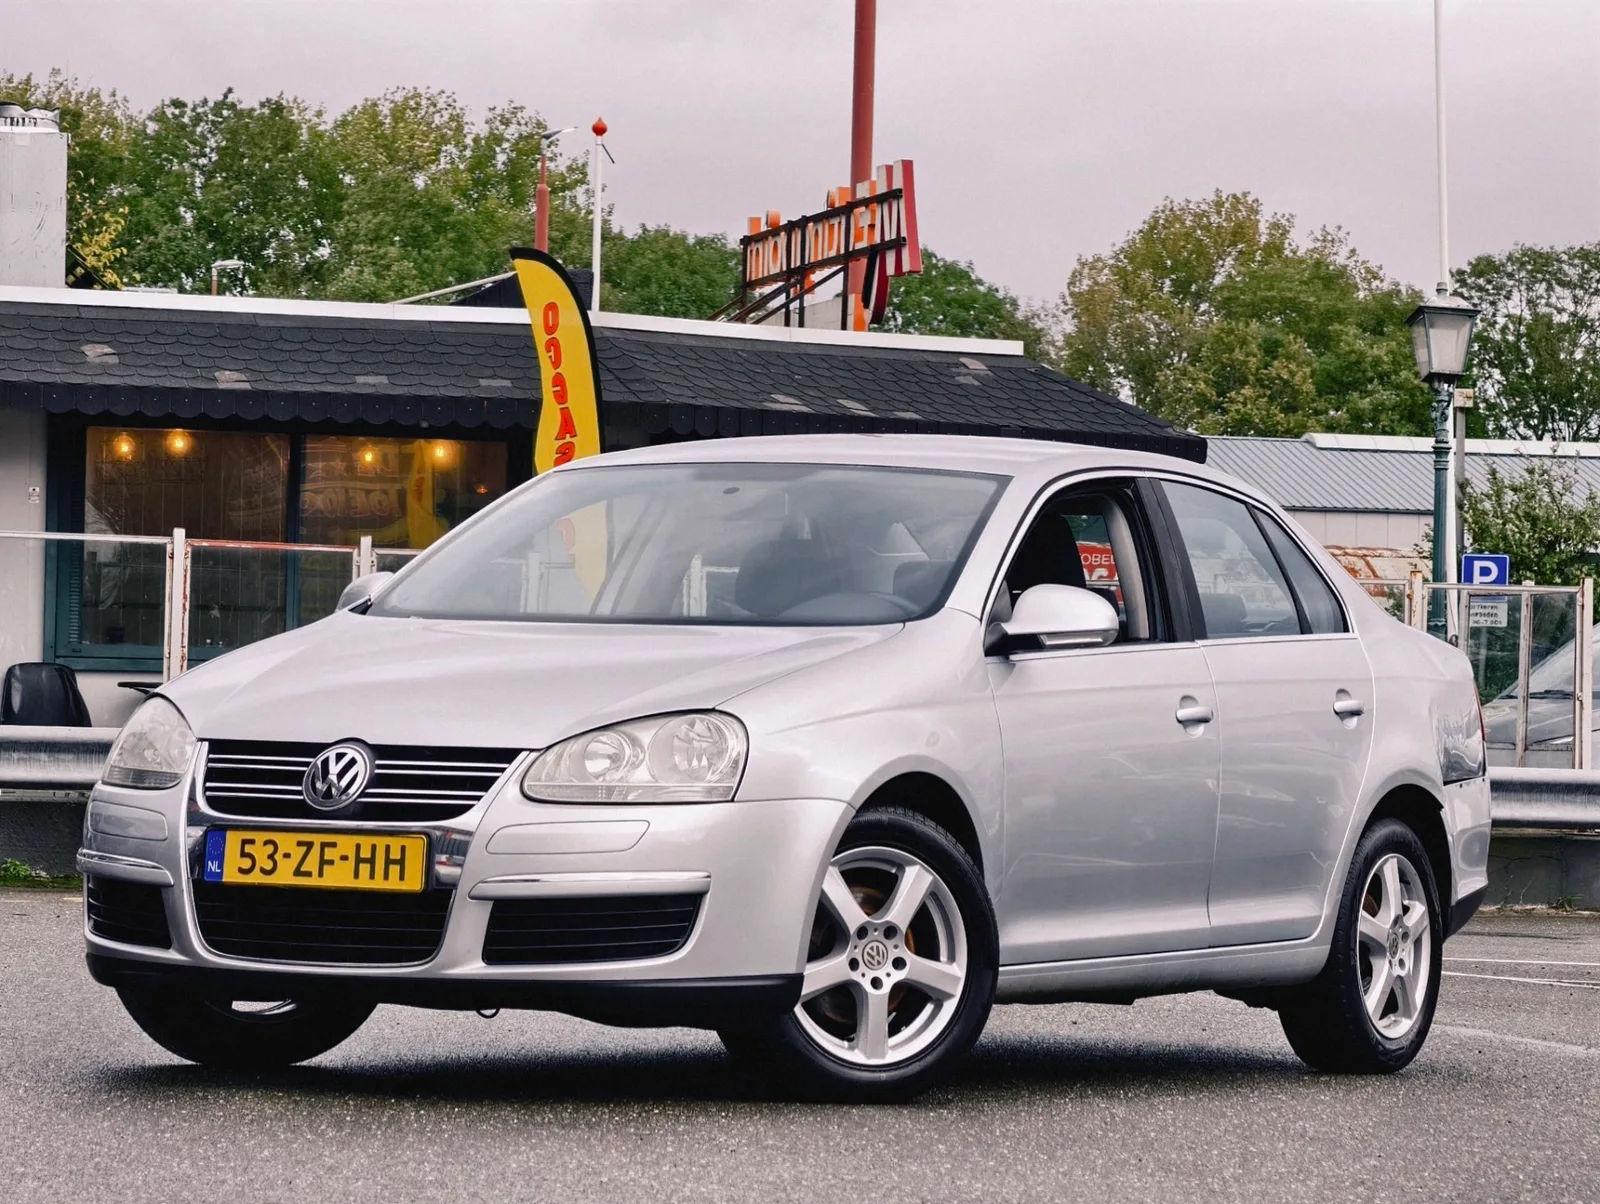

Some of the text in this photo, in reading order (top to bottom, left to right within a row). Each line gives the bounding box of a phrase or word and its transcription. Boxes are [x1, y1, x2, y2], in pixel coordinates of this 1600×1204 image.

[1473, 560, 1499, 586] P
[207, 860, 221, 873] NL
[237, 838, 407, 882] 53-ZF-HH
